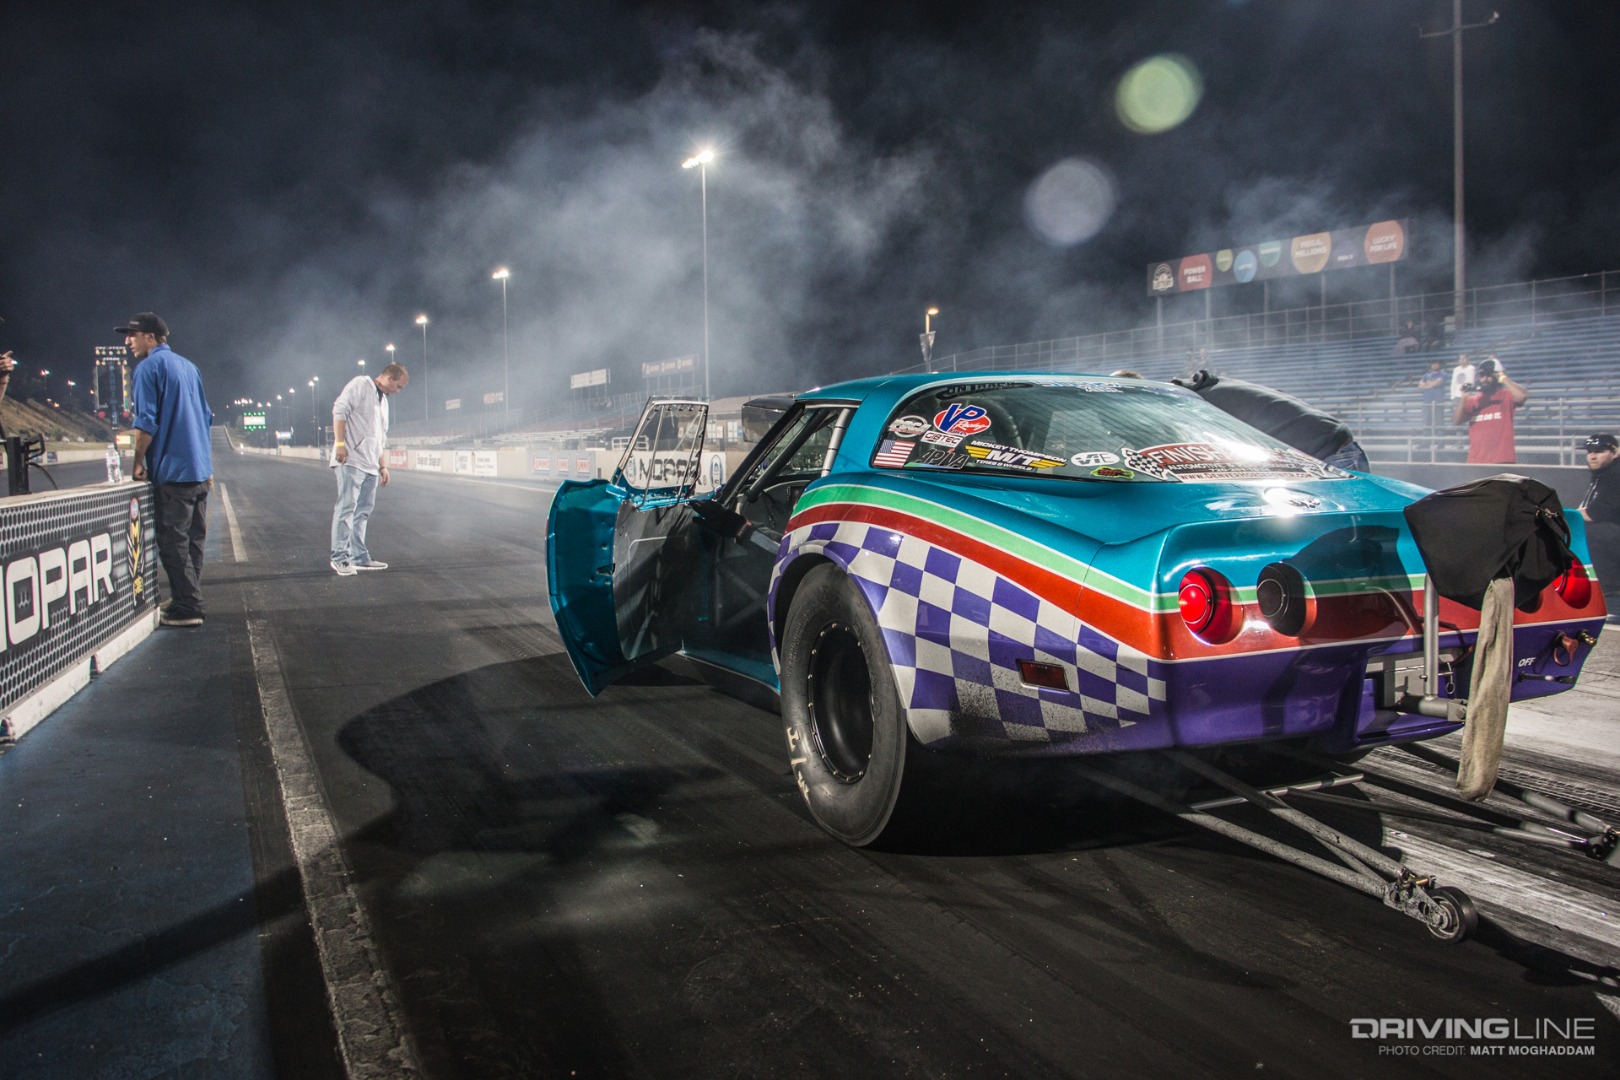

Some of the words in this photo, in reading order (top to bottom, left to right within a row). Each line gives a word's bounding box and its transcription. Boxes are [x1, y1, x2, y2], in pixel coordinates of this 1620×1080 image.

[1372, 235, 1396, 244] LUCKY
[1295, 246, 1327, 257] MILLIONS
[1370, 244, 1381, 253] FOR
[1383, 242, 1398, 251] LIFE
[1183, 265, 1206, 275] POWER
[1187, 274, 1203, 283] BALL
[938, 403, 987, 432] VP
[925, 431, 961, 445] GIBTEC
[971, 440, 1009, 451] MICKEY
[1009, 446, 1067, 463] THOMPSON
[986, 449, 1041, 466] M/T
[976, 459, 998, 467] TIRES
[1003, 462, 1033, 471] WHEELS
[1167, 462, 1227, 471] AUTOMOTIVE
[0, 532, 114, 653] OPAR
[1518, 656, 1536, 667] OFF
